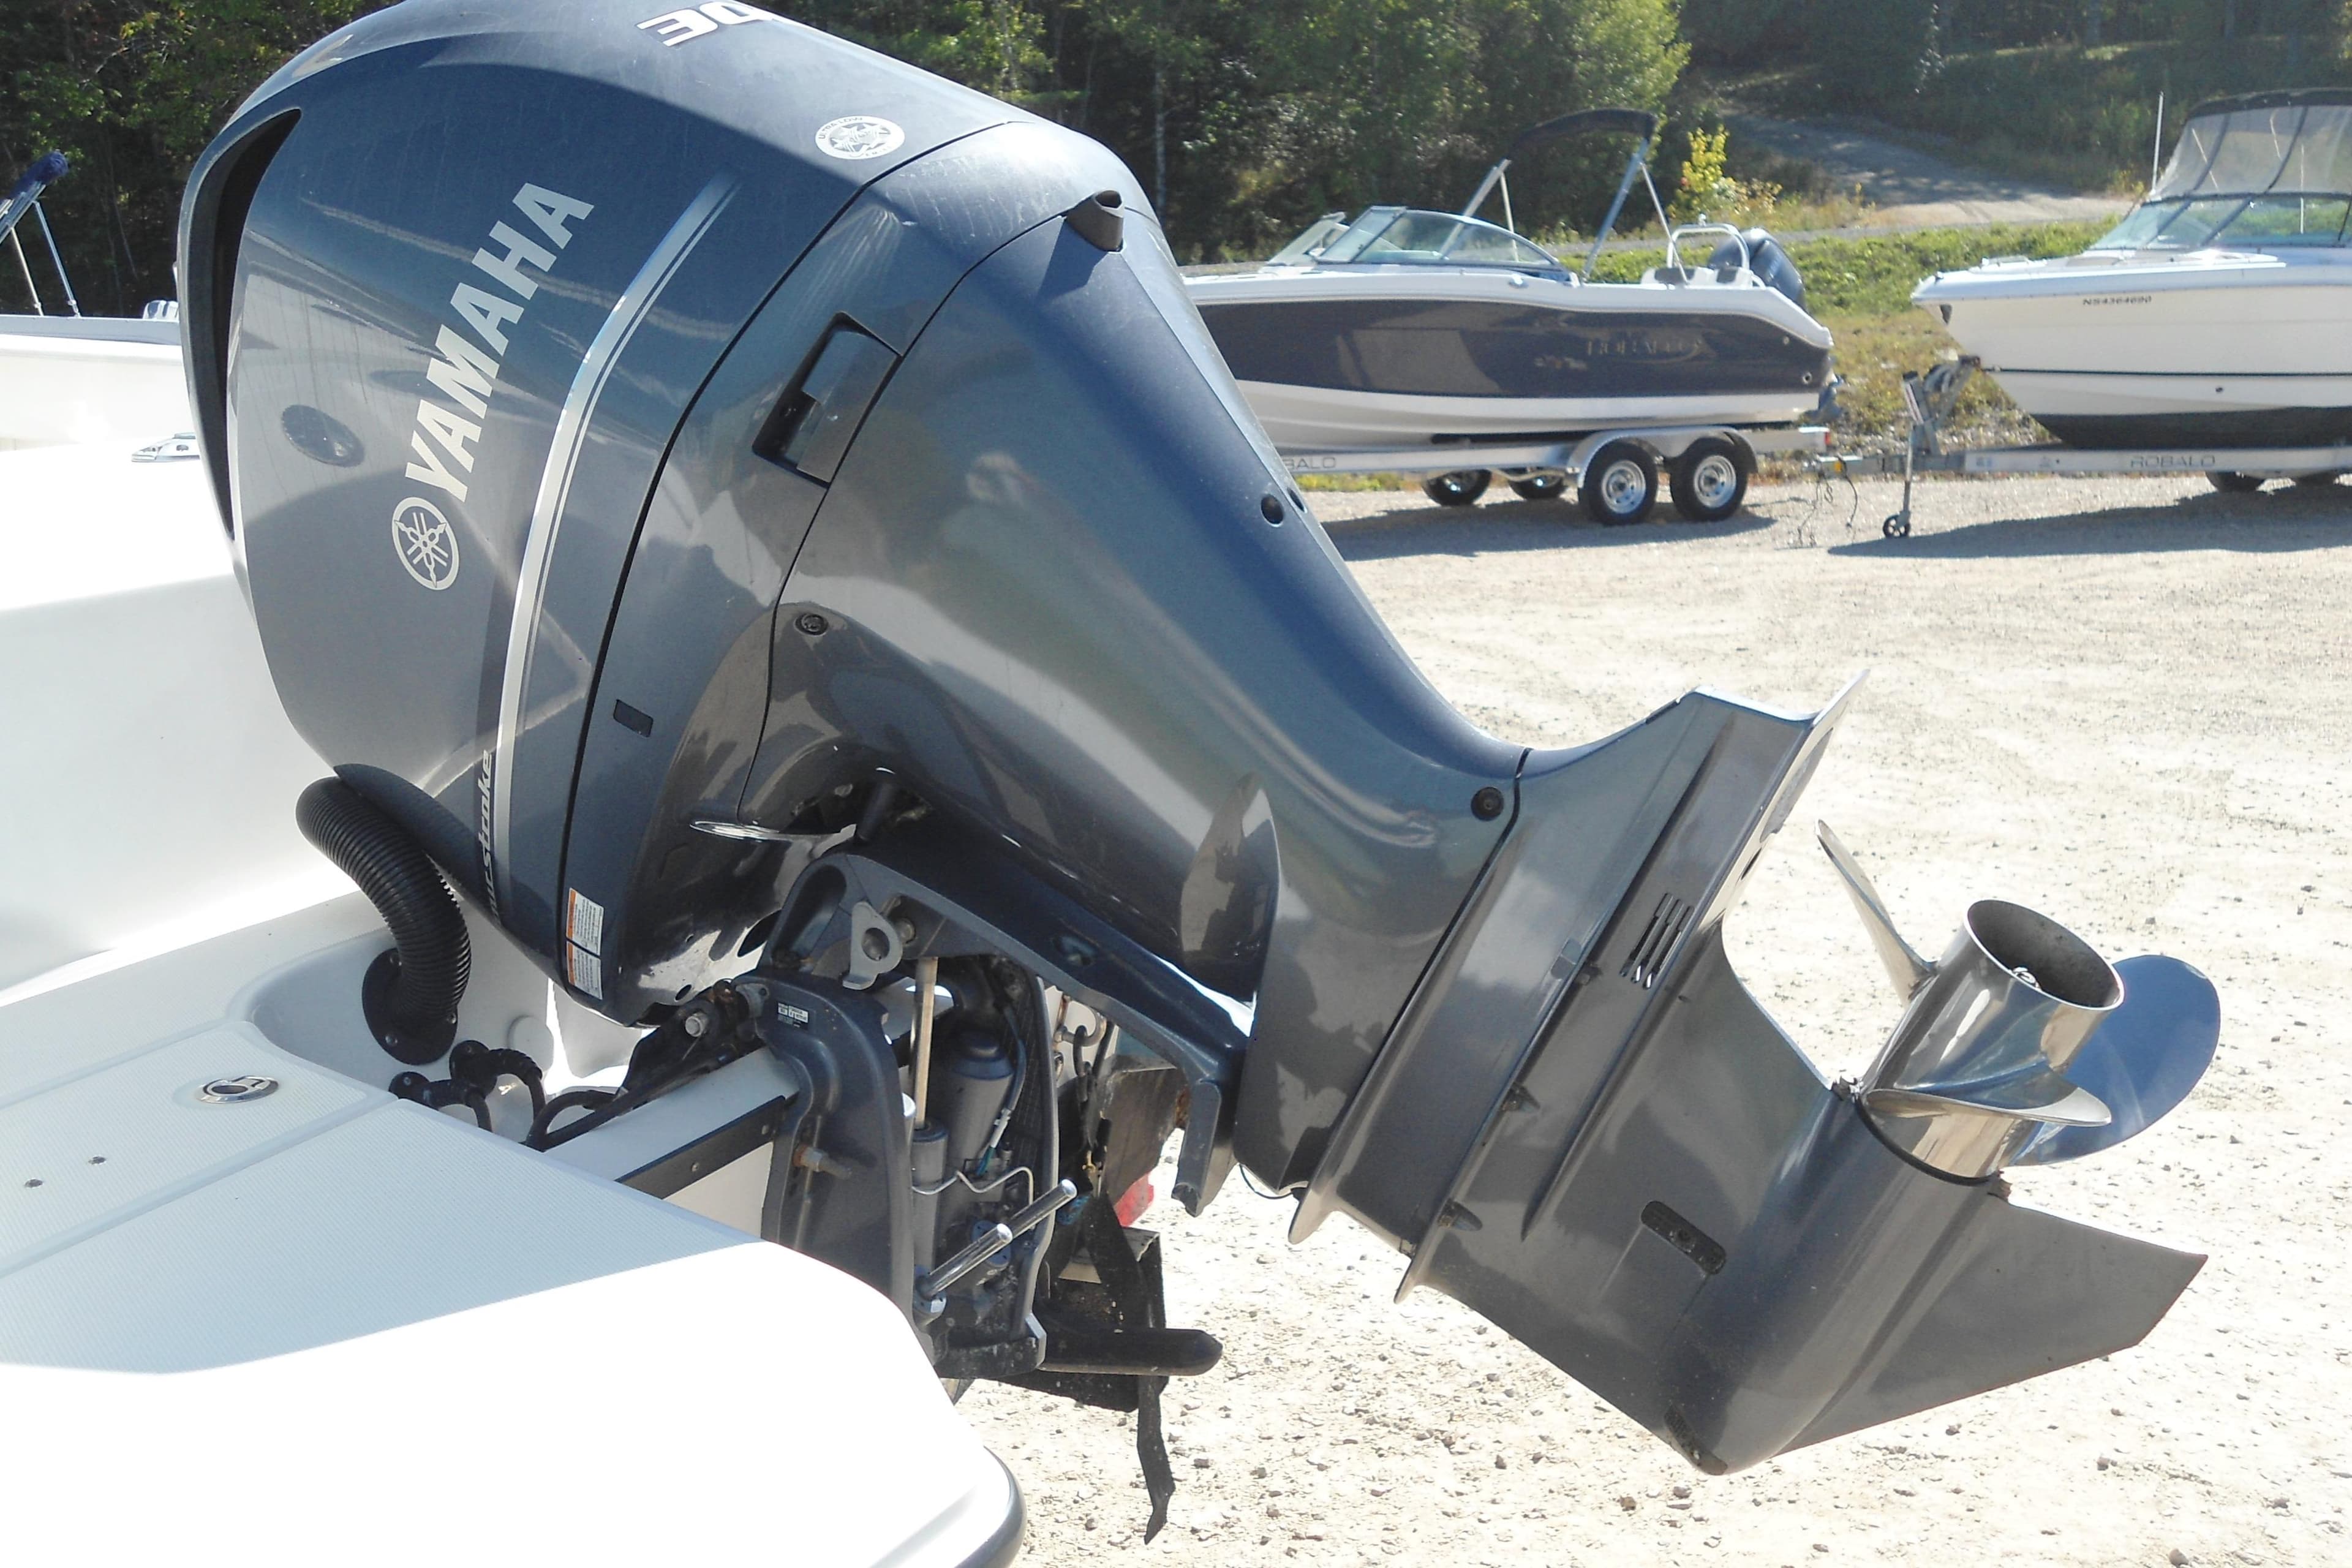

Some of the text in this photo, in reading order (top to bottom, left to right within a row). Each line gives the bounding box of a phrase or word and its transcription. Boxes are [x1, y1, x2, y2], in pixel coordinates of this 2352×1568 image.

[404, 183, 594, 503] YAMAHA
[1283, 457, 1336, 471] BALO
[2130, 454, 2215, 469] ROBALO
